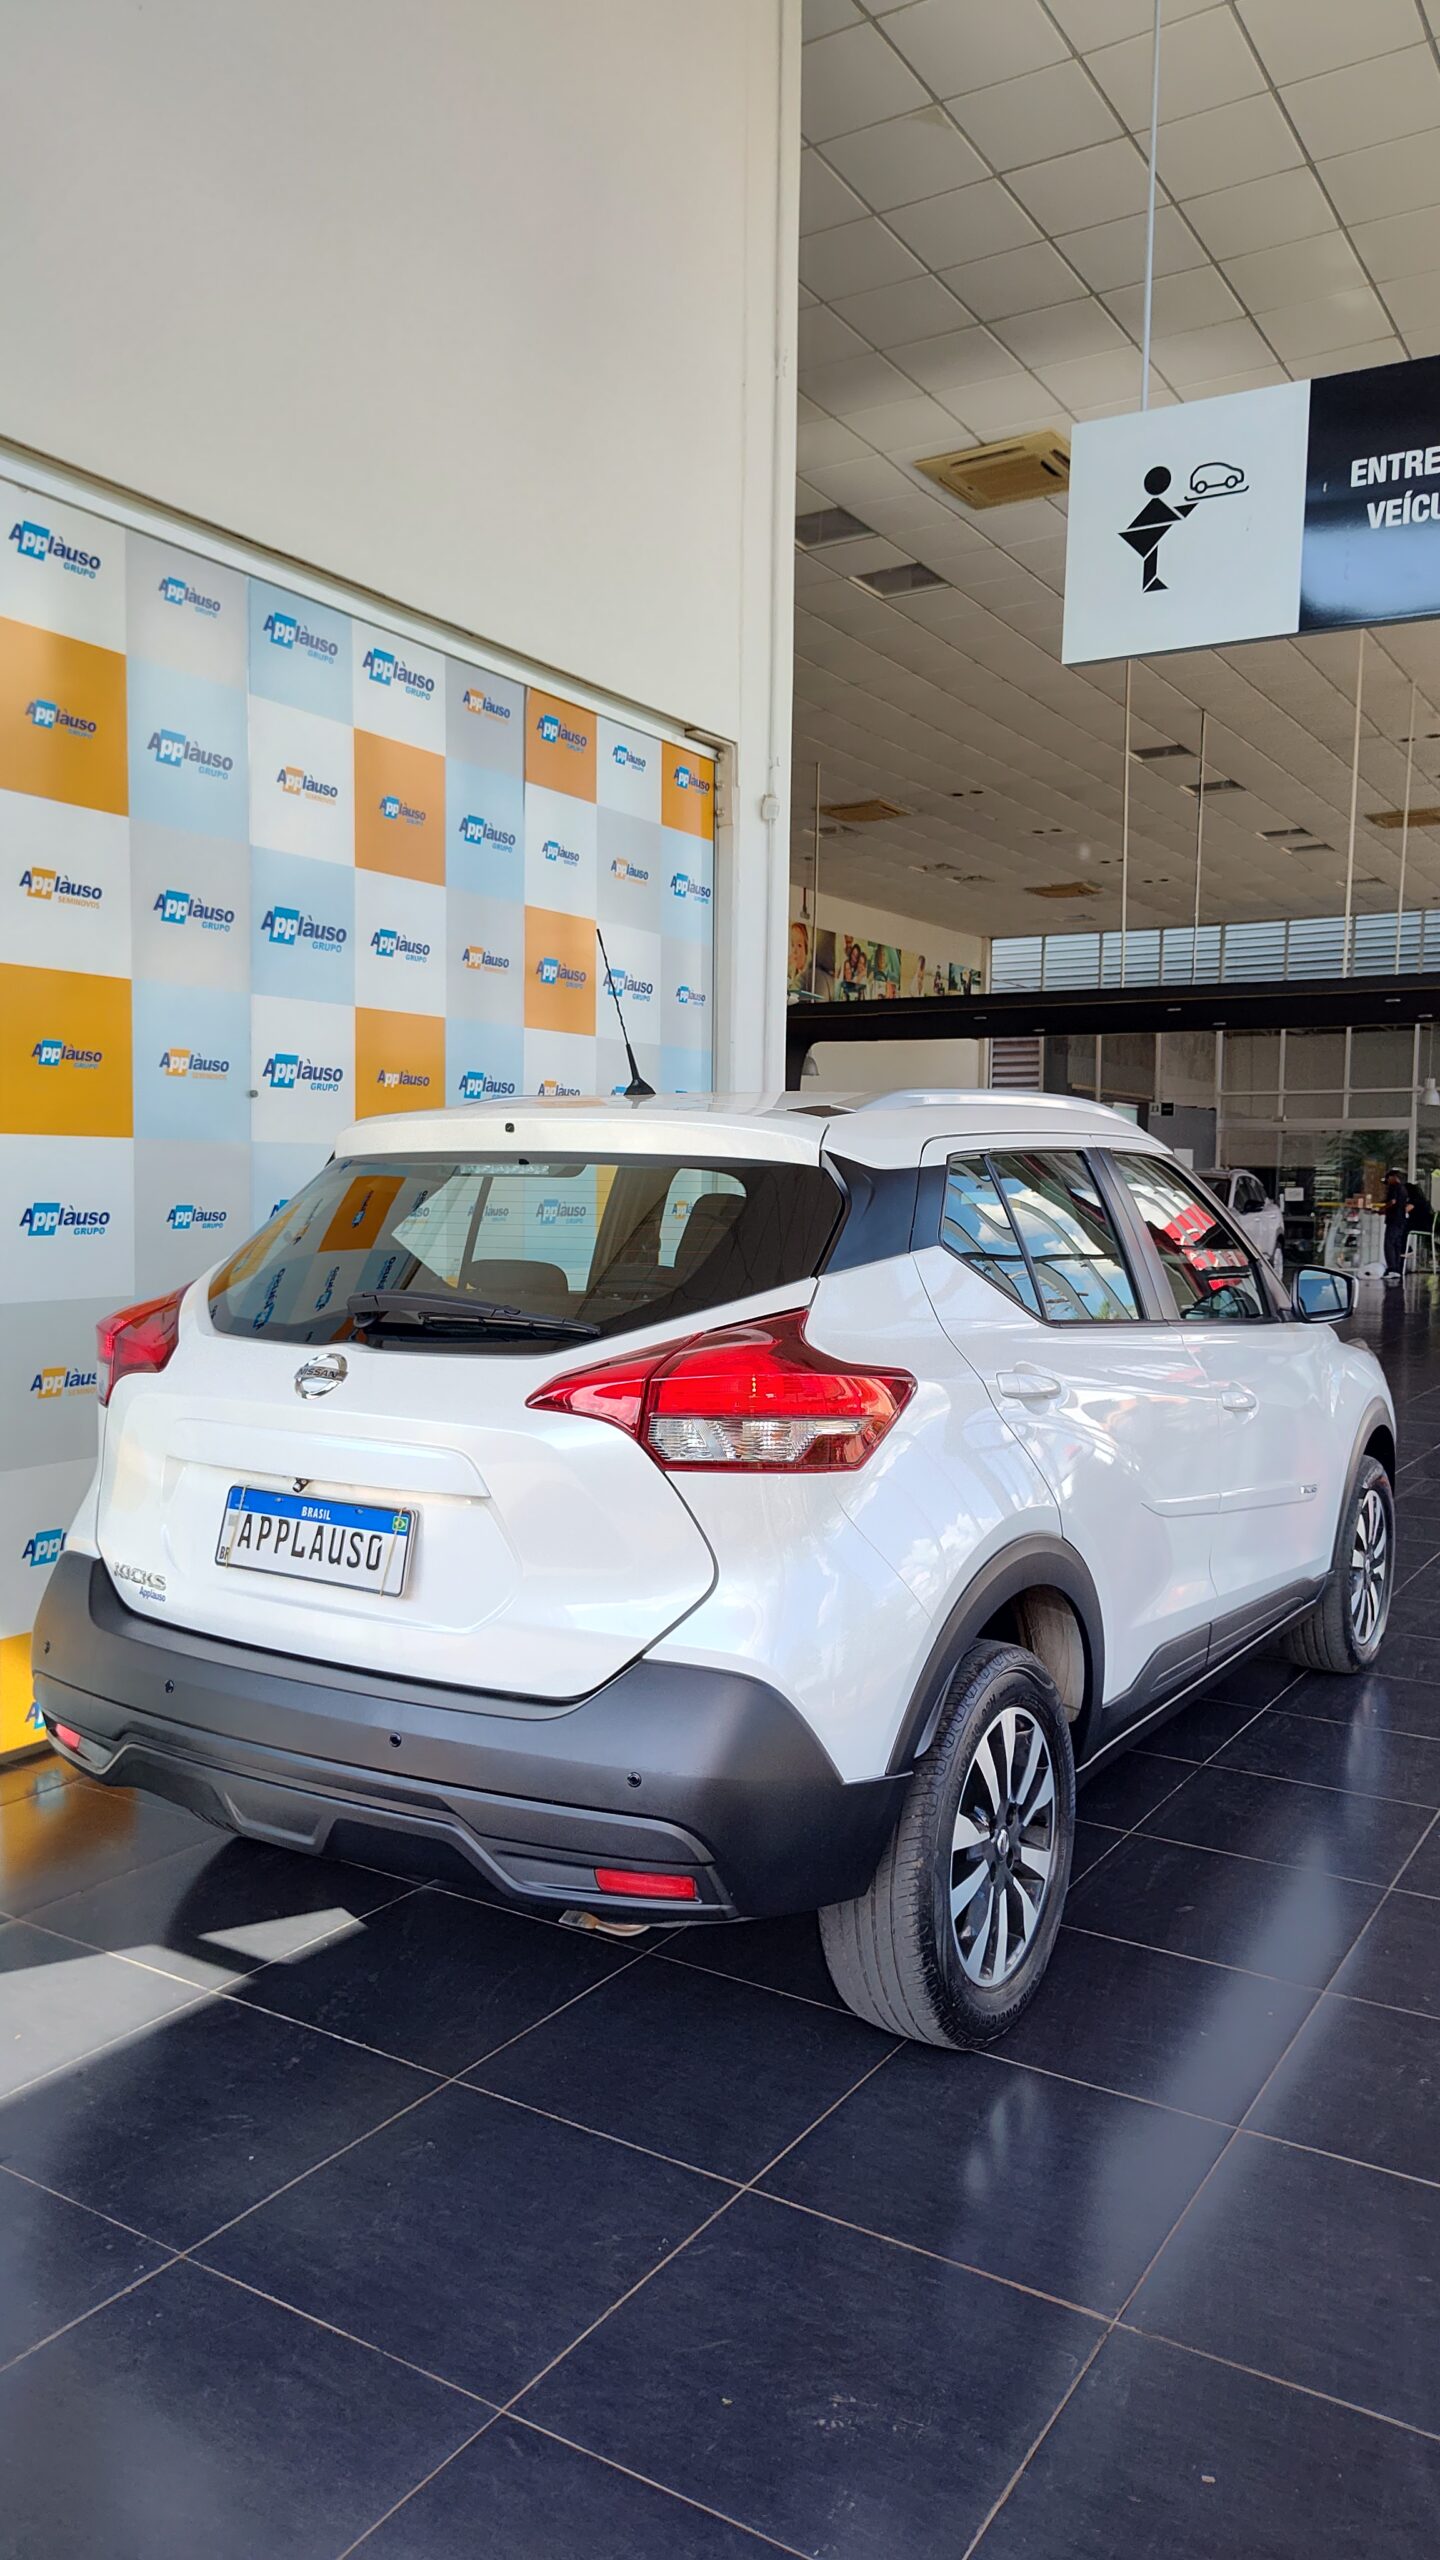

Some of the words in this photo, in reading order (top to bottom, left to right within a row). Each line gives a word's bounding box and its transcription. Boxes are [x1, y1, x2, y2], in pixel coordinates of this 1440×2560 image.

[9, 522, 101, 569] Applàuso
[63, 562, 96, 579] GRUPO
[159, 577, 220, 612] Applàuso
[263, 614, 338, 656] Applàuso
[307, 649, 334, 664] GRUPO
[363, 650, 435, 692] Applàuso
[405, 685, 430, 700] GRUPO
[147, 731, 233, 771] Applàuso
[198, 765, 229, 780] GRUPO
[19, 869, 102, 900] Applàuso
[58, 895, 100, 909] SEMINOVOS
[153, 893, 234, 924] Applàuso
[201, 921, 230, 932] GRUPO
[261, 910, 347, 943] Applàuso
[312, 940, 342, 953] GRUPO
[370, 931, 430, 956] Applàuso
[32, 1042, 102, 1064] Applàuso
[159, 1051, 229, 1073] Applàuso
[262, 1056, 343, 1082] Applàuso
[310, 1081, 339, 1092] GRUPO
[20, 1204, 110, 1227] Applàuso
[167, 1205, 227, 1223] Applàuso
[73, 1227, 105, 1235] GRUPO
[30, 1368, 97, 1391] Applàus
[300, 1368, 338, 1378] NISSAN
[301, 1506, 331, 1520] BRASIL
[237, 1513, 383, 1571] APPLAUSO
[114, 1561, 166, 1591] KICKS
